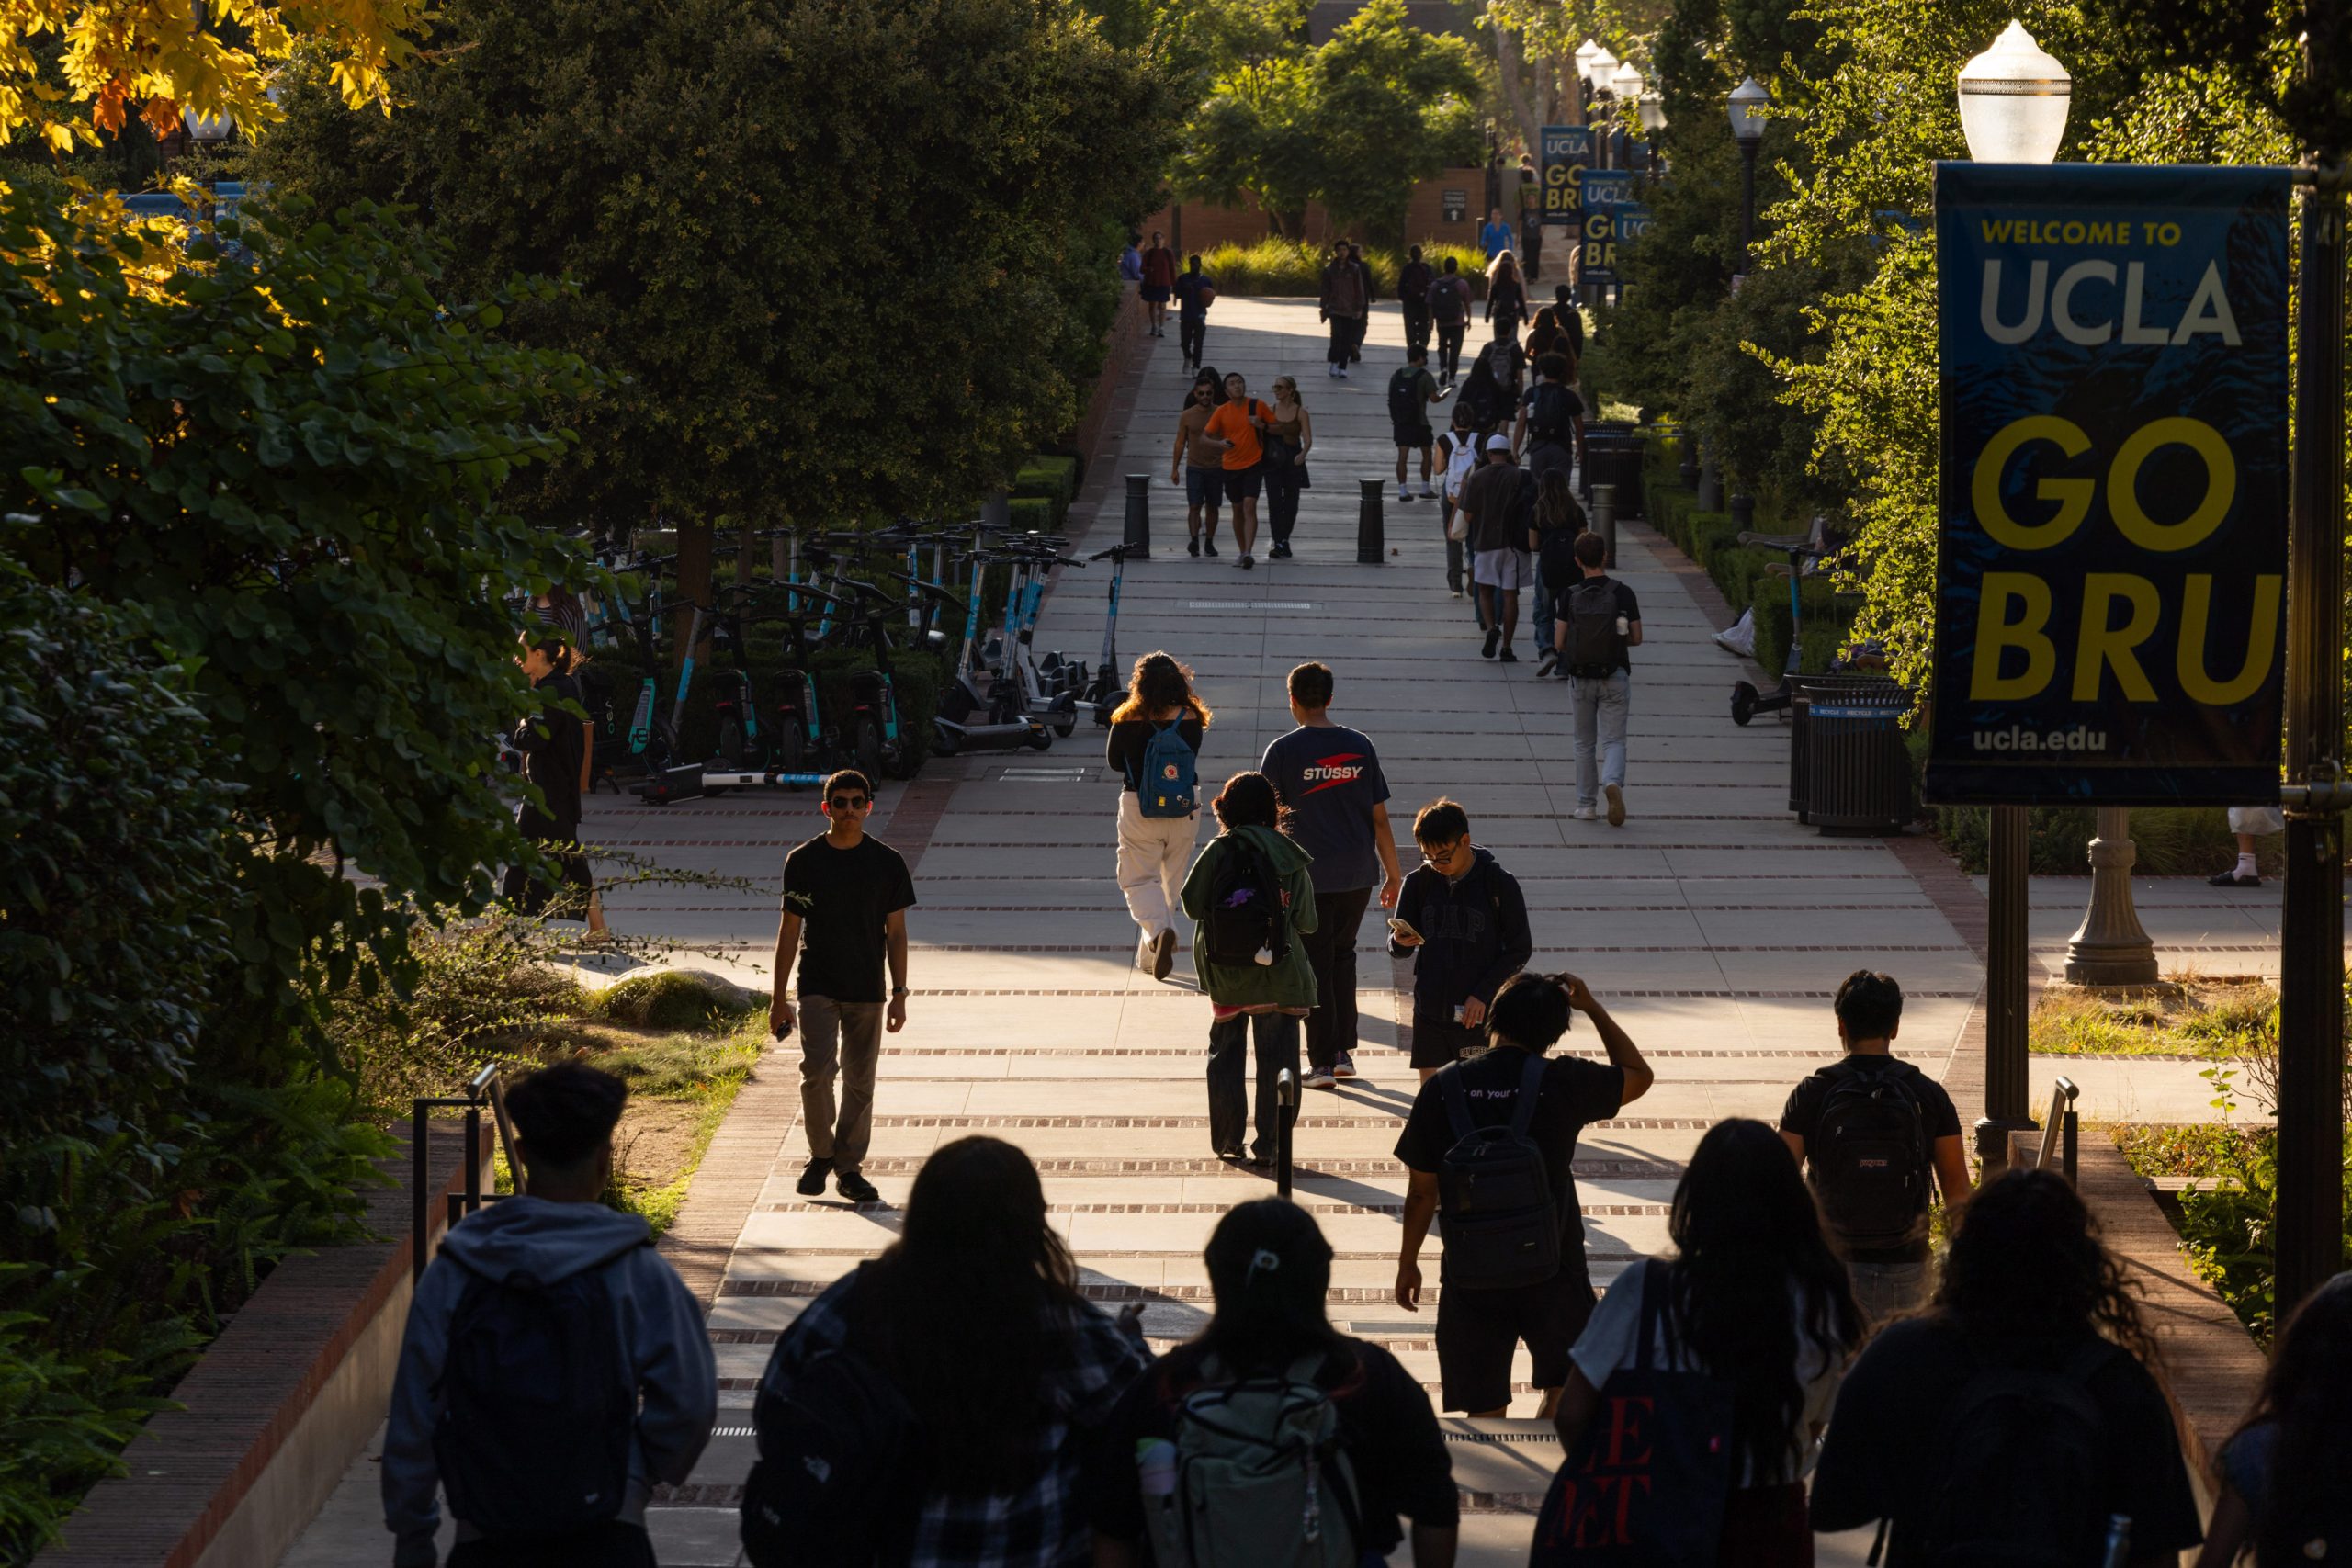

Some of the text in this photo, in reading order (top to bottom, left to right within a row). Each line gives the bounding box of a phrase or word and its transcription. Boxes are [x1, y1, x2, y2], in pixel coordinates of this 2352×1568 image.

[1546, 140, 1589, 154] UCLA
[1585, 214, 1616, 240] G
[1981, 220, 2182, 246] WELCOME TO
[1979, 258, 2243, 346] UCLA
[1972, 414, 2237, 553] GO
[1969, 571, 2283, 705] BRU
[1973, 725, 2107, 751] ucla.edu
[1303, 764, 1363, 781] STÜSSY
[1420, 904, 1486, 942] GAP
[1470, 1089, 1484, 1098] on
[1487, 1089, 1511, 1100] your
